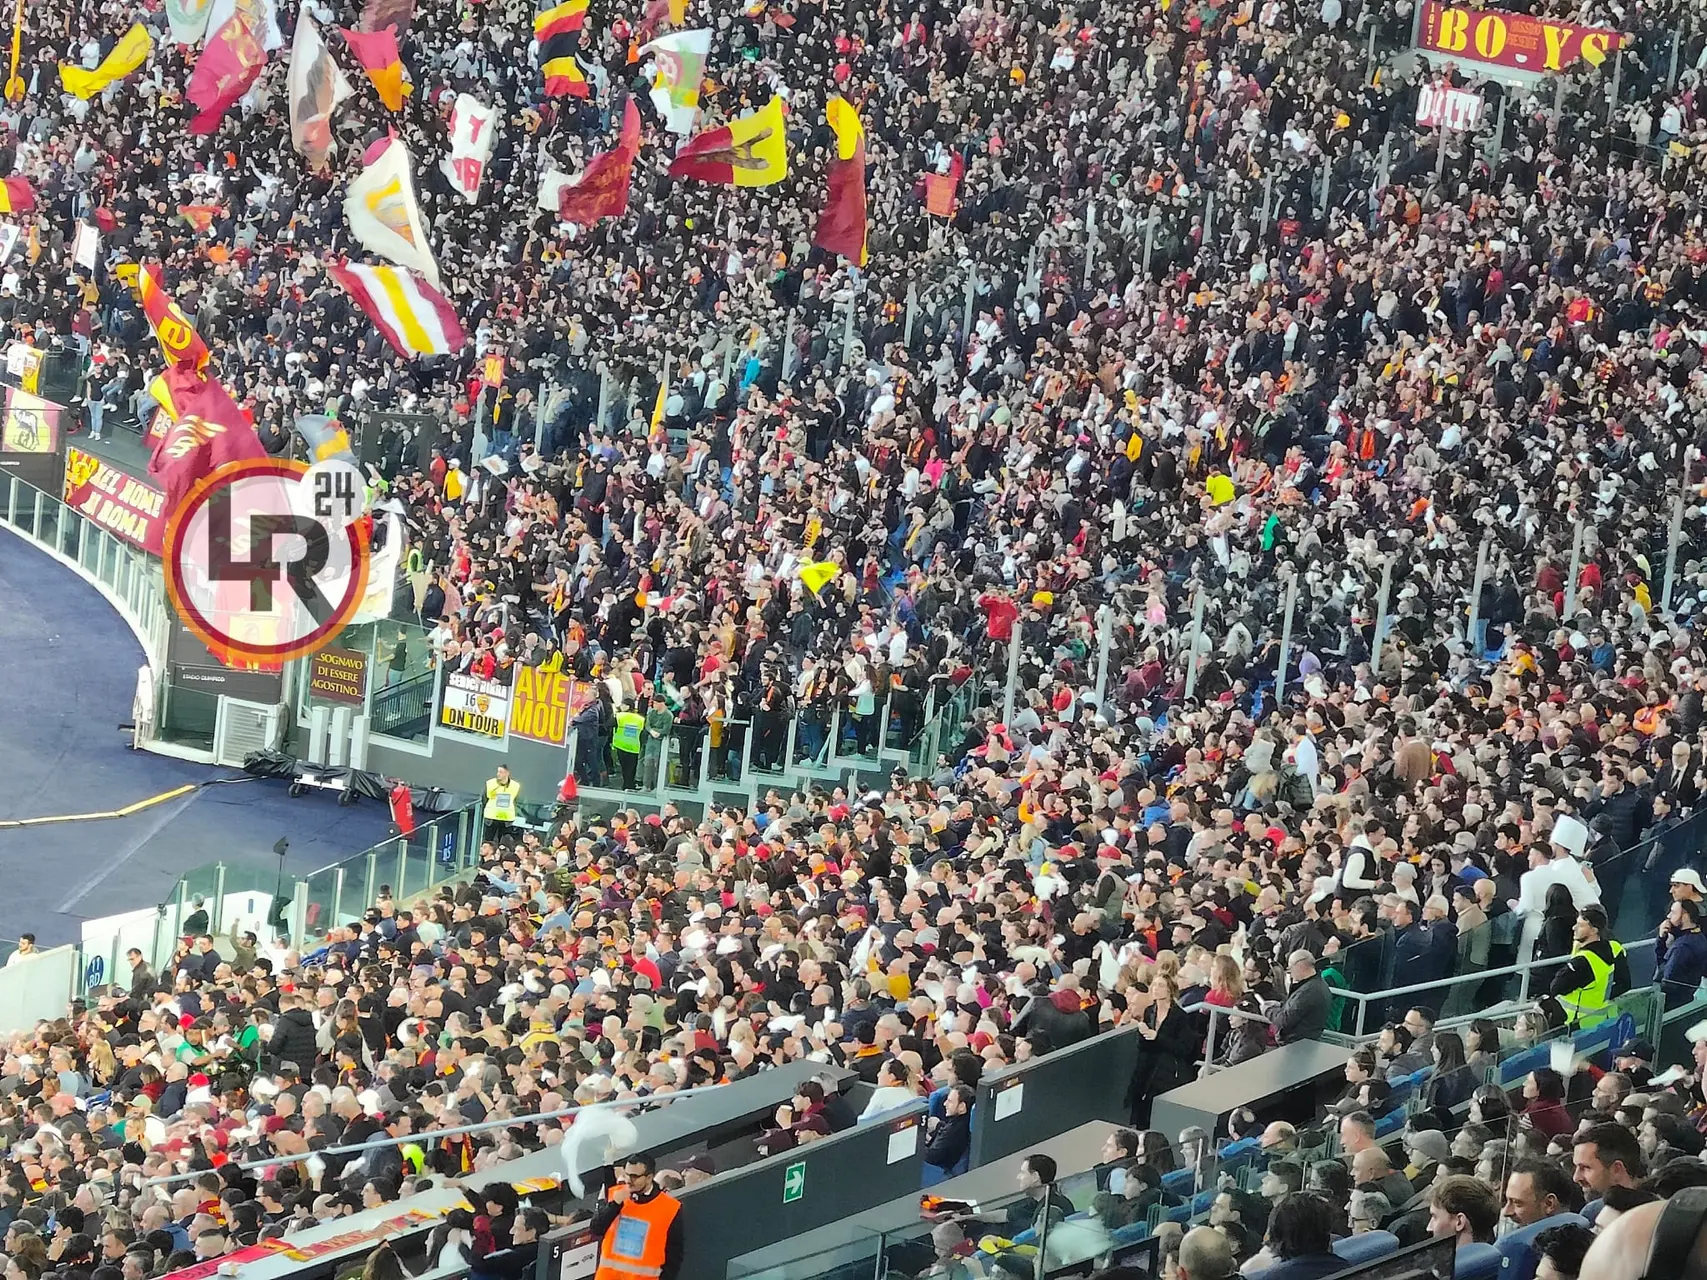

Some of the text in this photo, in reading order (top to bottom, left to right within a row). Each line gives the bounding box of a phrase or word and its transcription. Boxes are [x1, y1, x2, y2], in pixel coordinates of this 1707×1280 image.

[117, 479, 164, 518] NOME
[96, 500, 149, 543] ROMA
[318, 666, 358, 682] DI ESSERE
[515, 665, 570, 708] AVE
[465, 693, 476, 707] 16
[448, 708, 499, 735] ON TOUR
[511, 697, 566, 742] MOU
[92, 956, 100, 972] 11
[921, 1114, 927, 1127] 3
[553, 1245, 560, 1259] 5
[1502, 1256, 1509, 1268] 8
